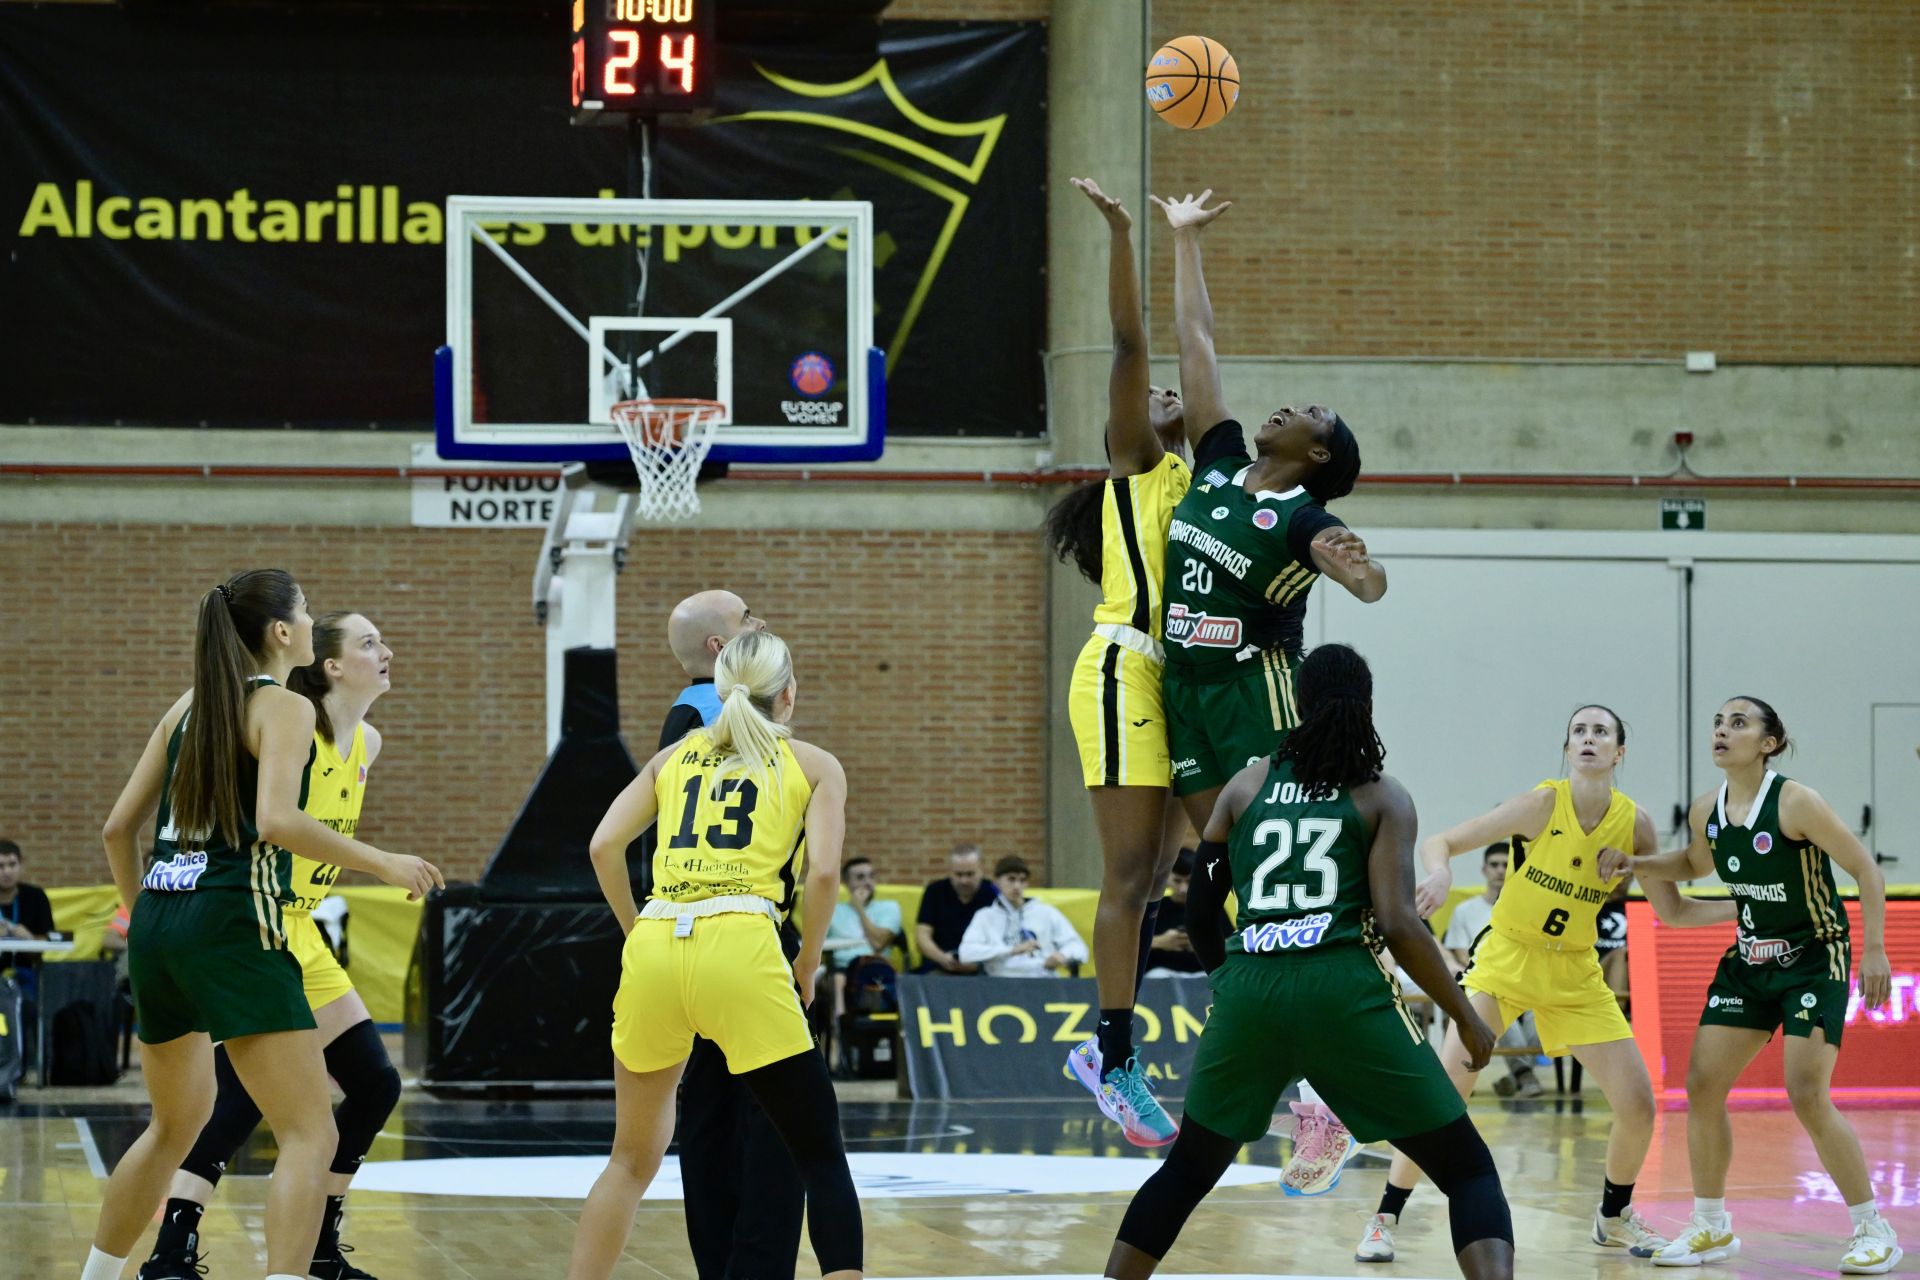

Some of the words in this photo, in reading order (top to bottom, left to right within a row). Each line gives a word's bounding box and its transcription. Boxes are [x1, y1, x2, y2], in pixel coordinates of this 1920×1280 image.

[604, 31, 694, 94] 24
[18, 180, 443, 246] Alcantarilla
[571, 188, 848, 263] dpote
[781, 401, 843, 414] EUROCUP
[785, 412, 838, 424] WOMEN
[444, 475, 560, 492] FONDO
[451, 499, 553, 521] NORTE
[1182, 558, 1213, 595] 20
[668, 775, 758, 850] 13
[170, 853, 206, 868] Juice
[688, 858, 750, 876] Hacienda
[1248, 818, 1342, 910] 23
[1525, 866, 1574, 897] HOZONO
[1286, 915, 1329, 927] Juice
[1542, 908, 1570, 937] 6
[1244, 926, 1325, 952] Viva
